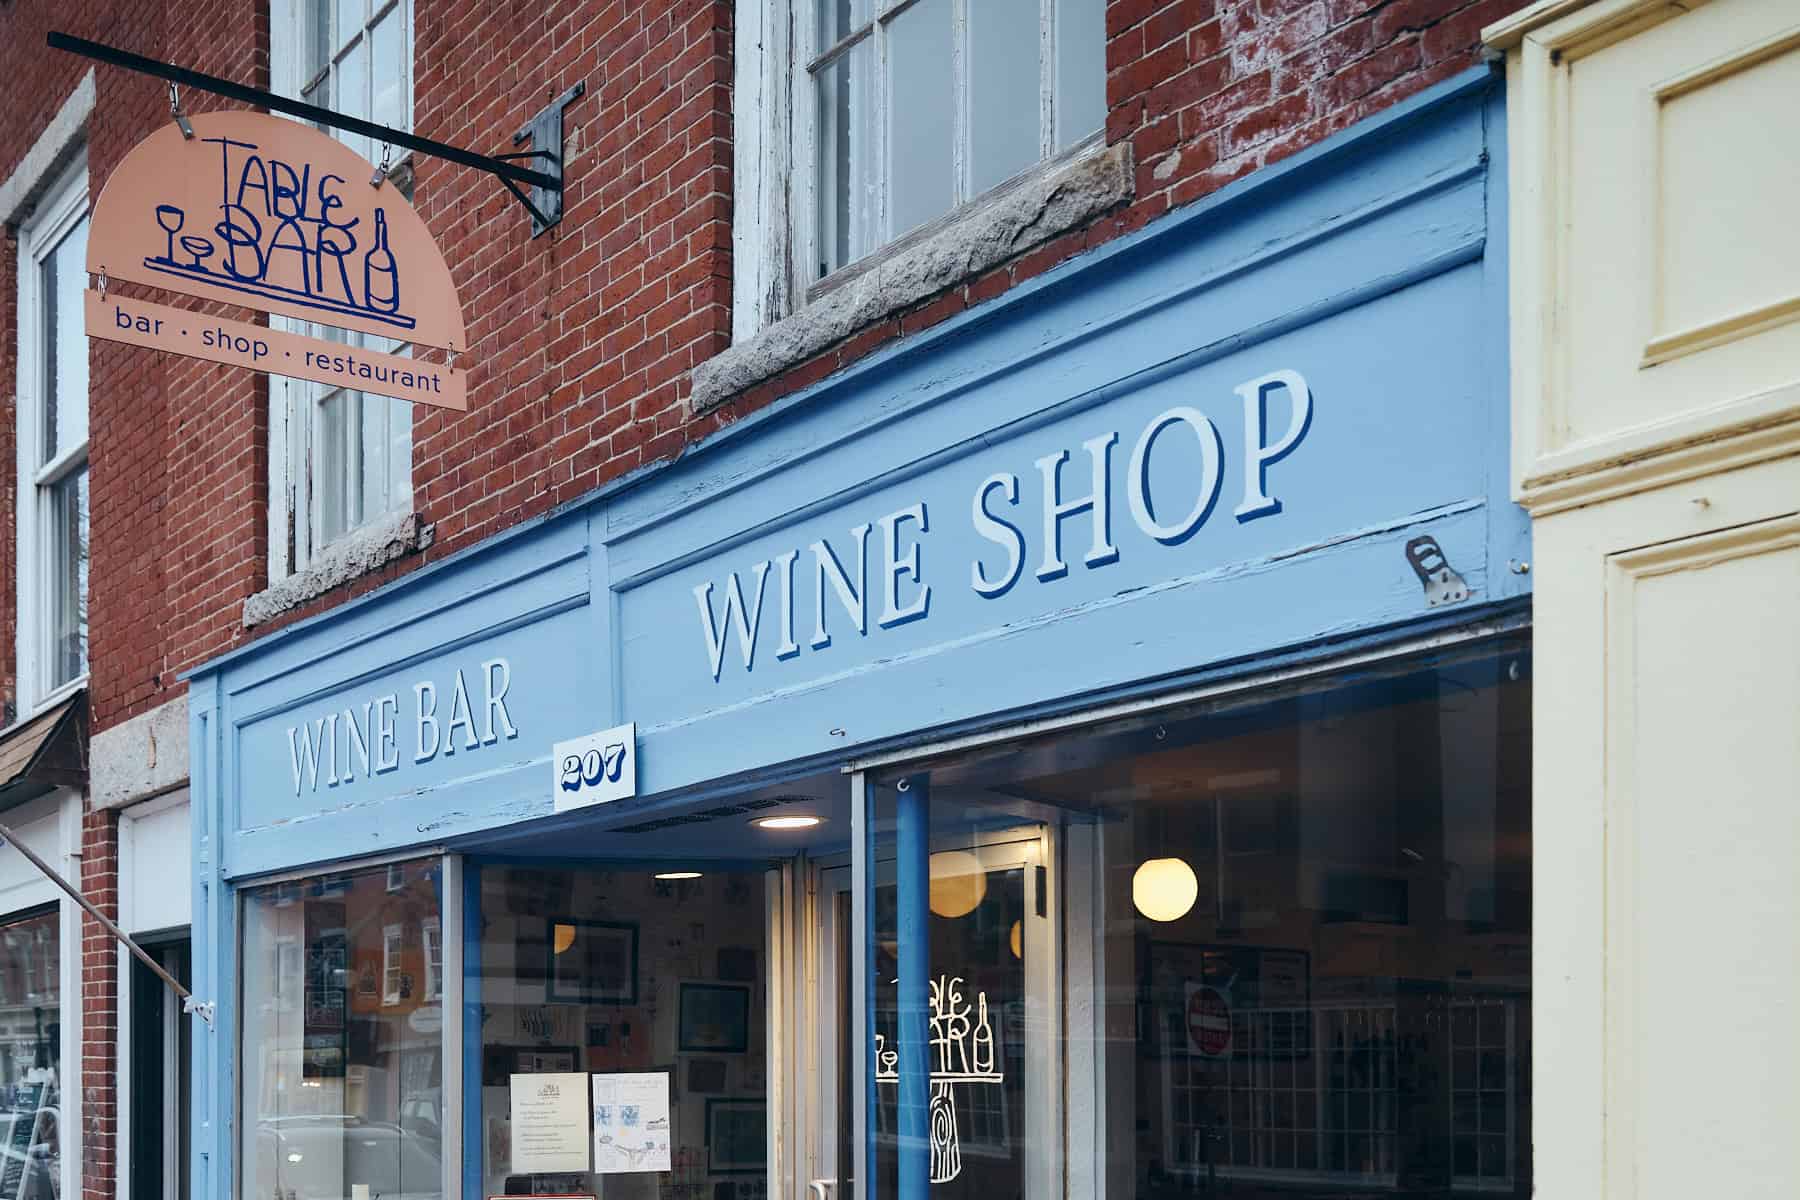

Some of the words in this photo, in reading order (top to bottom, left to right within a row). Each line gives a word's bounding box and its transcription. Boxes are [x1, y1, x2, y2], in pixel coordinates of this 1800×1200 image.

[214, 204, 359, 306] BAR
[116, 306, 164, 336] bar
[202, 325, 269, 359] shop
[305, 347, 441, 394] restaurant
[693, 502, 931, 684] WINE
[970, 368, 1313, 600] SHOP
[287, 693, 400, 797] WINE
[413, 657, 519, 765] BAR
[560, 742, 627, 793] 207
